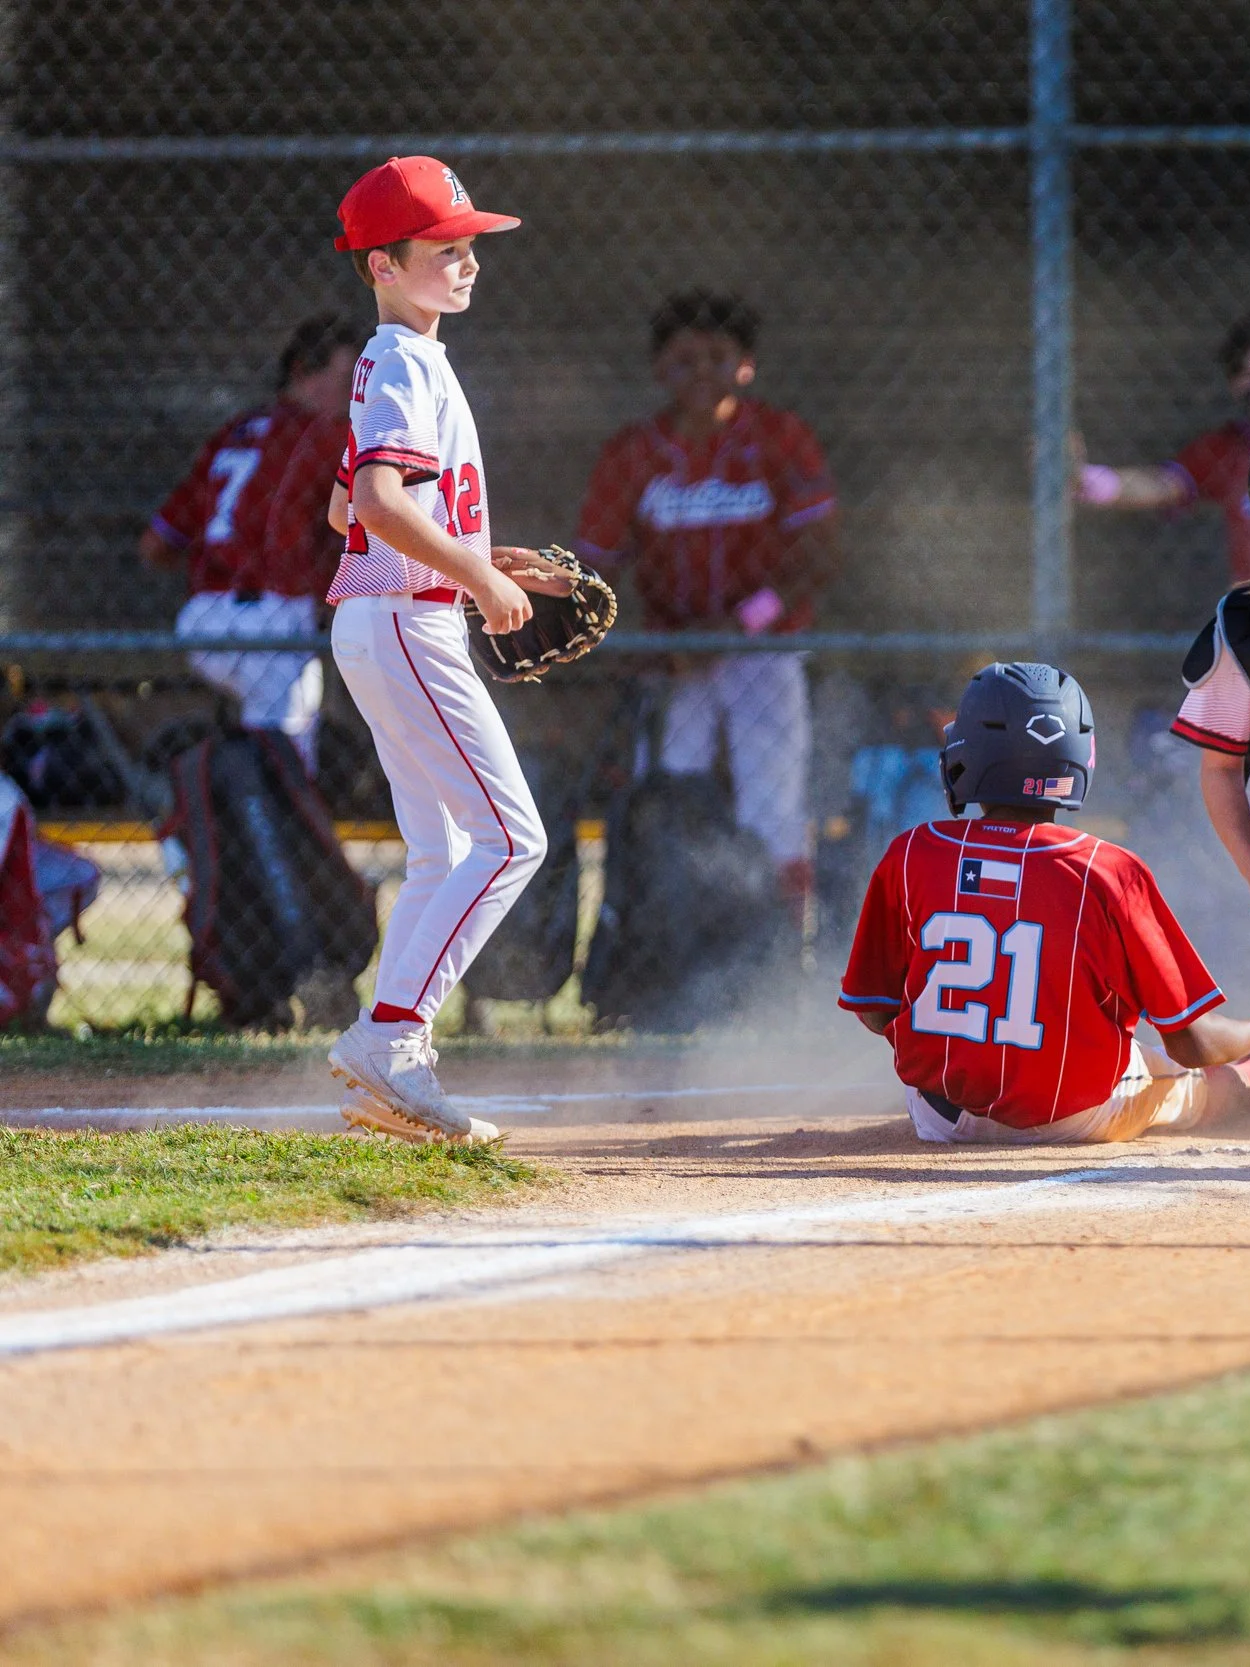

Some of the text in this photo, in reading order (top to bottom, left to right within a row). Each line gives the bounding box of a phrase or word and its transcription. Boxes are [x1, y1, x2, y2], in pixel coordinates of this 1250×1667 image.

[205, 447, 262, 543] 7
[437, 463, 482, 537] 12
[1022, 777, 1044, 796] 21
[911, 911, 1045, 1051] 21
